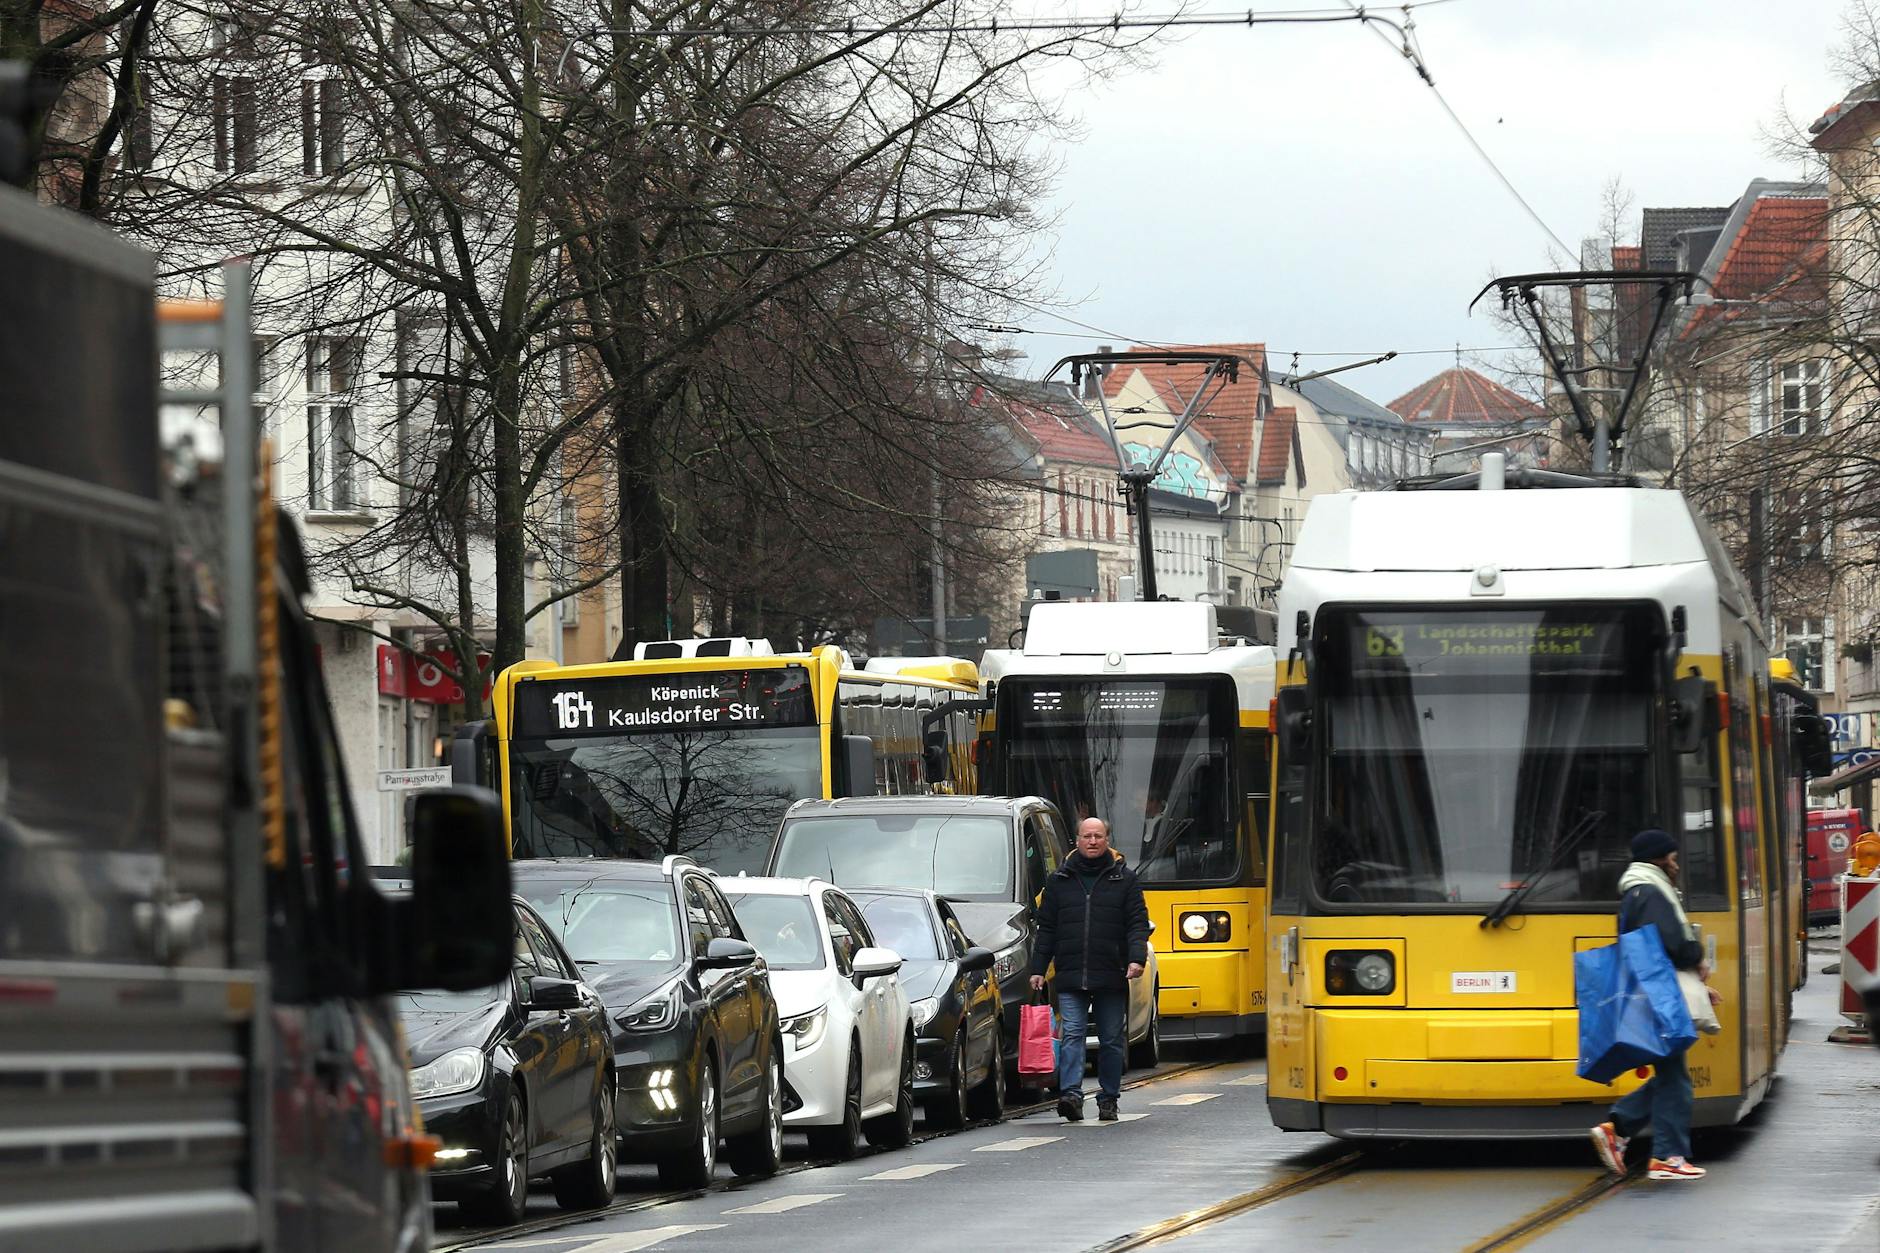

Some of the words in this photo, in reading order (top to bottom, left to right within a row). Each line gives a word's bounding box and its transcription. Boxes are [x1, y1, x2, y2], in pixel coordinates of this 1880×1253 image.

[1366, 624, 1405, 657] 63
[1418, 623, 1596, 640] Landschaftspark
[1439, 639, 1582, 656] Johannisthal
[651, 684, 720, 702] Köpenick
[551, 690, 594, 729] 164
[608, 704, 721, 727] Kaulsdorfer
[728, 702, 765, 722] Str.
[1456, 978, 1491, 987] BERLIN
